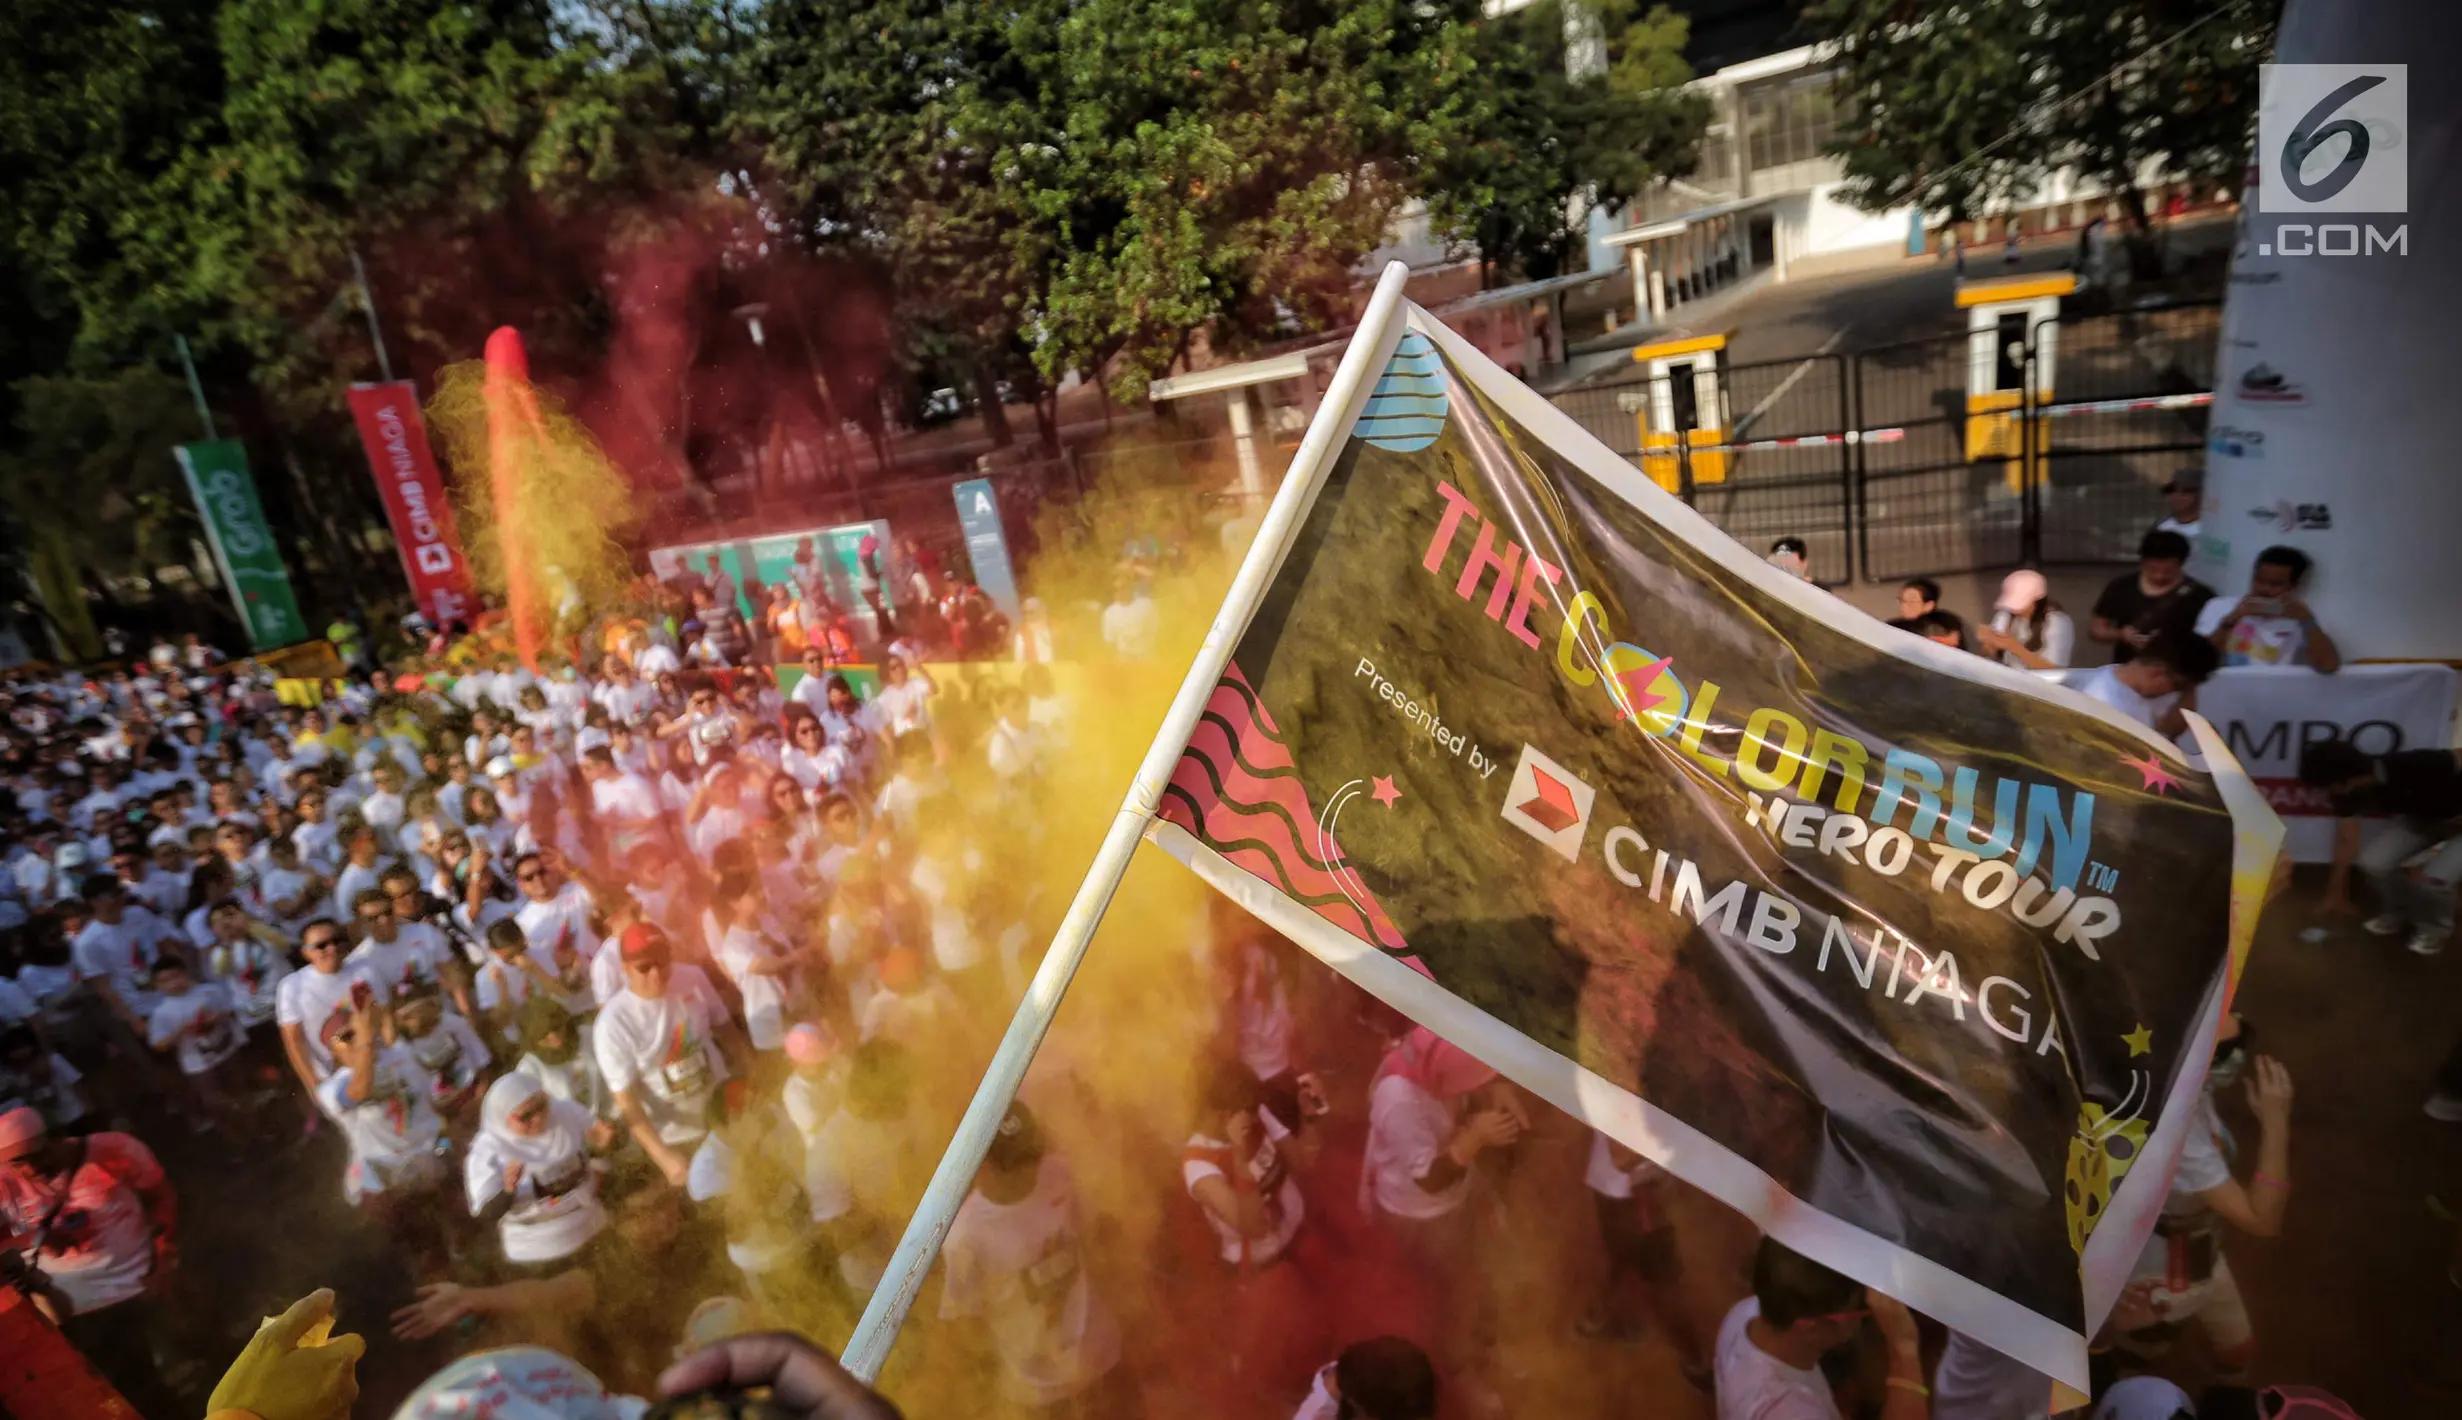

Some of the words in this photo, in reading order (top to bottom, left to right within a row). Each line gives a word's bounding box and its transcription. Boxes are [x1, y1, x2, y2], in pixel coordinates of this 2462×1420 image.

[974, 490, 993, 512] A
[1354, 657, 1466, 756] Presented
[1468, 744, 1497, 780] by
[1422, 480, 1562, 651] THE
[1869, 747, 2095, 892] RUN
[1603, 825, 1801, 955] CIMB
[1744, 791, 1914, 876] HERO
[1928, 842, 2121, 961] TOUR
